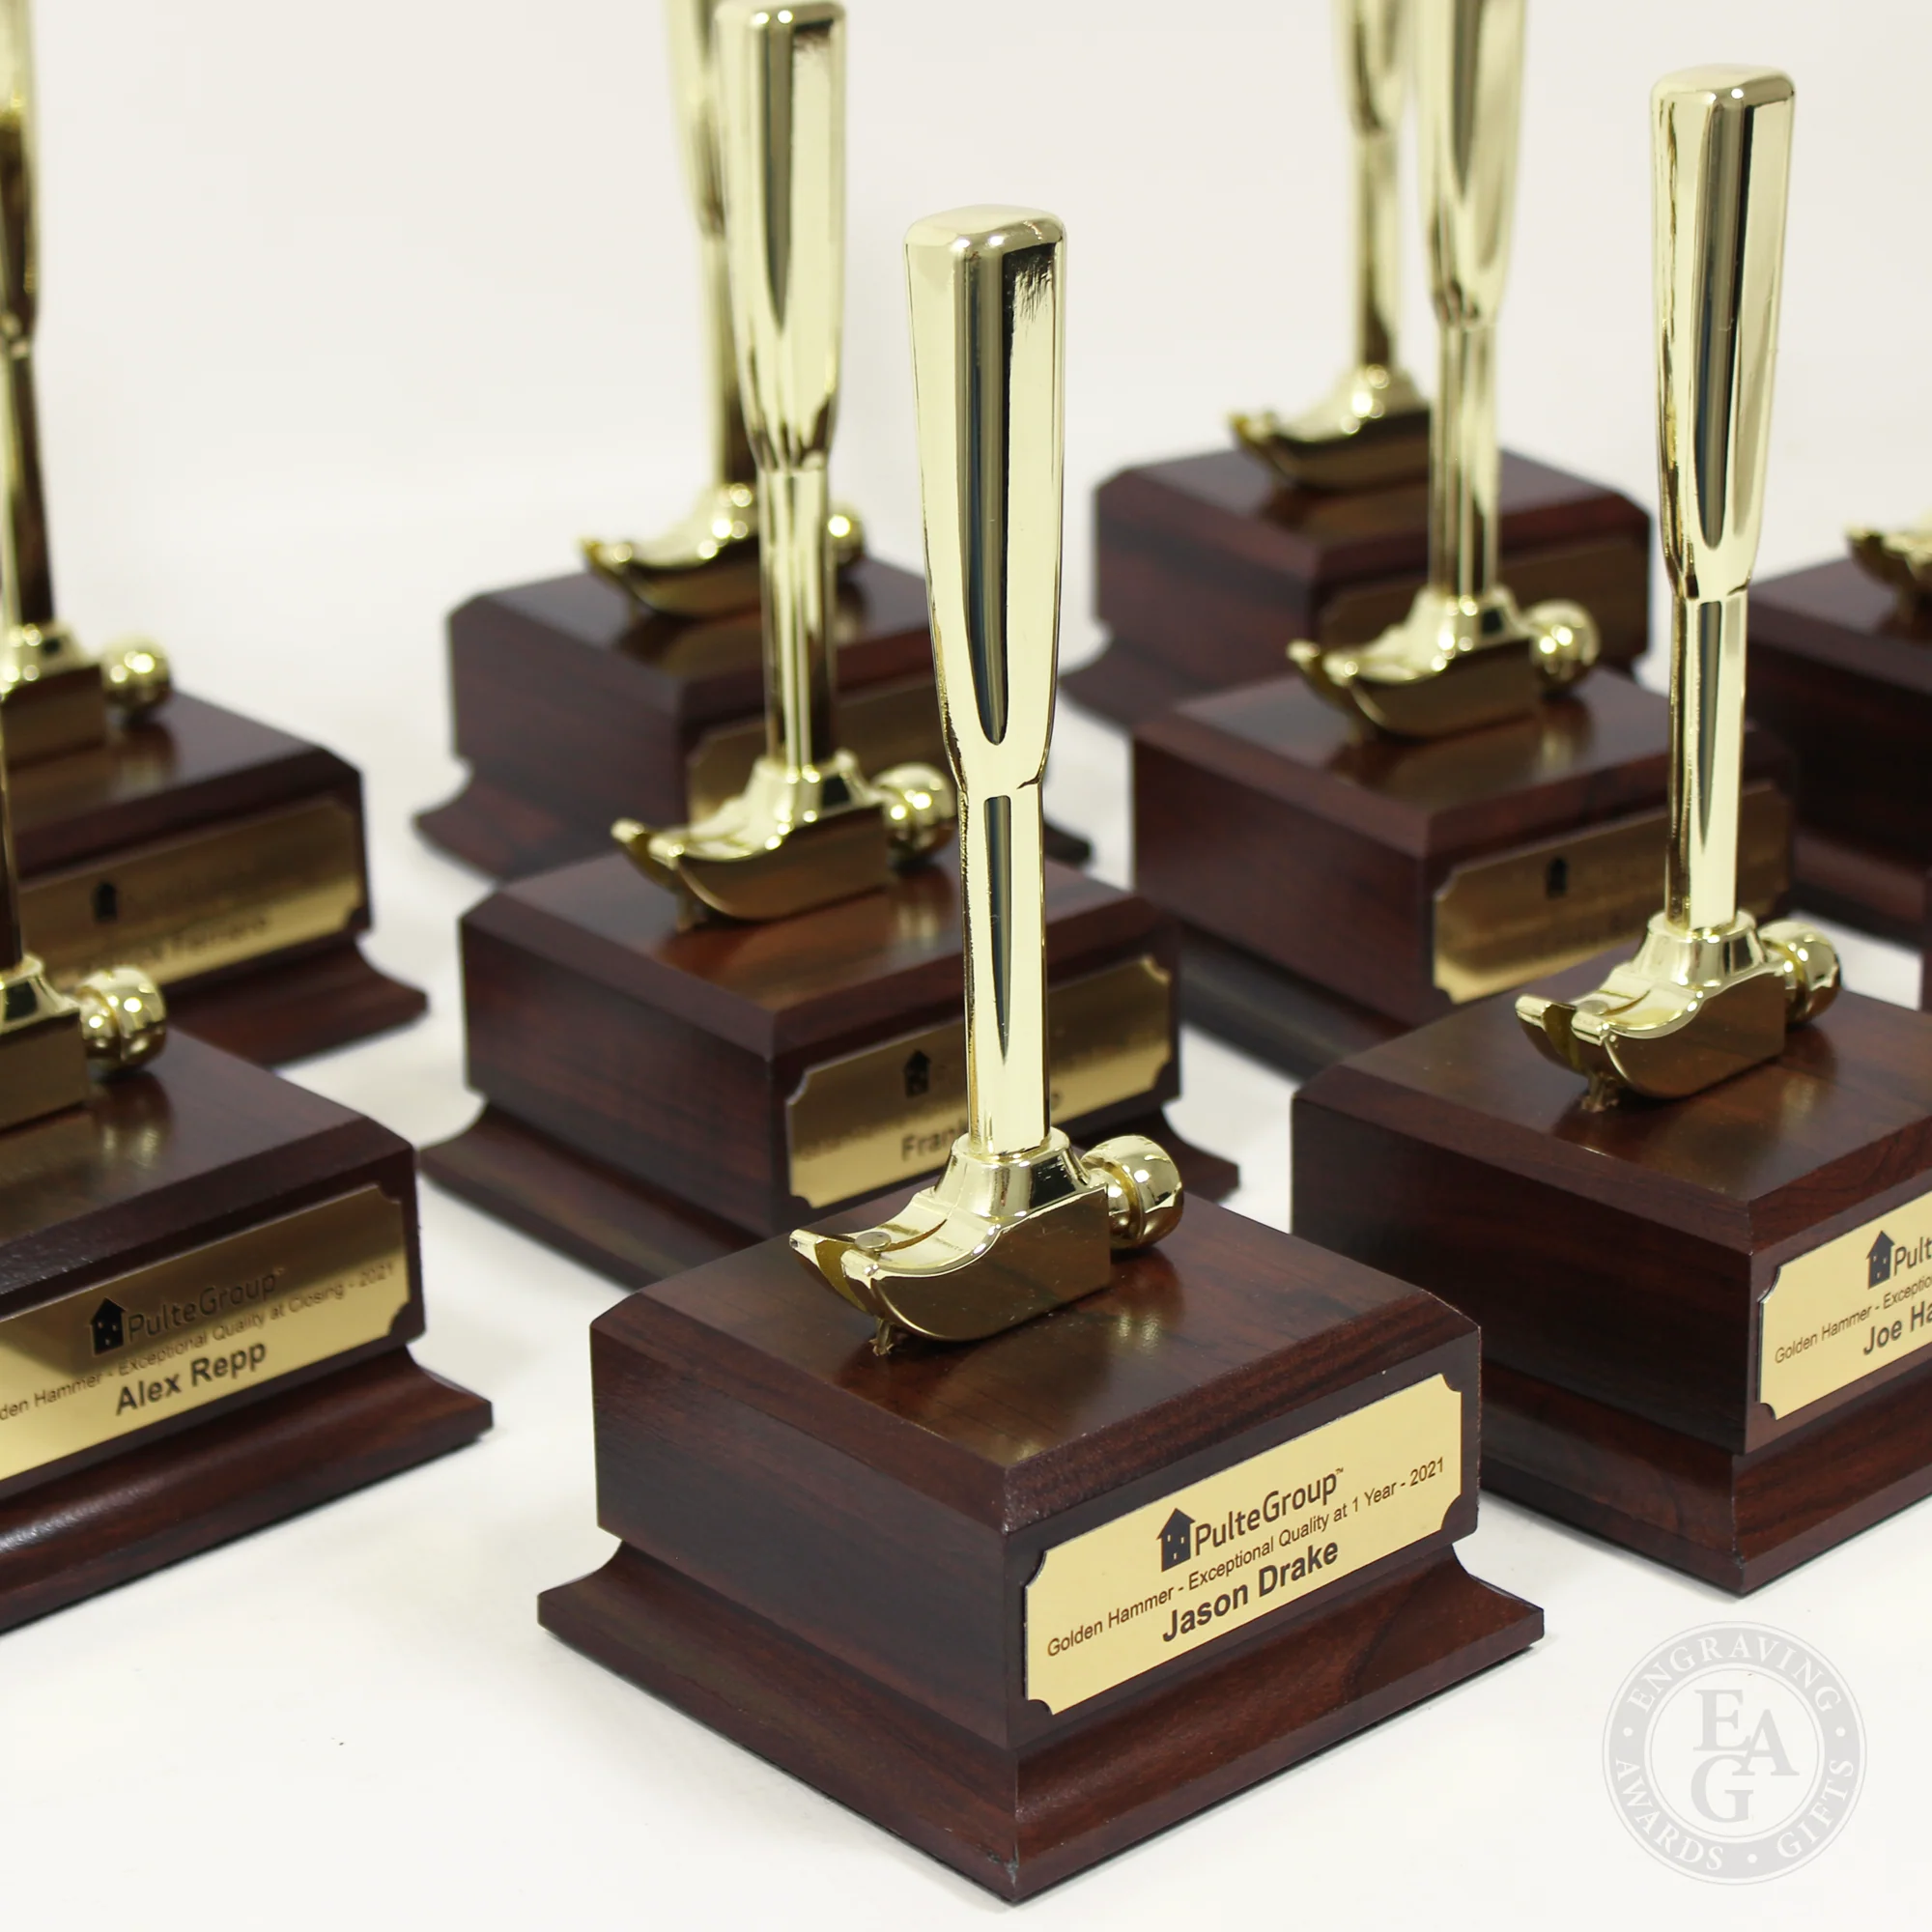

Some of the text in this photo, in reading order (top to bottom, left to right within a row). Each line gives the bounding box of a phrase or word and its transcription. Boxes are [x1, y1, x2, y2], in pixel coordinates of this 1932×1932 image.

[34, 1373, 102, 1407] Hammer
[119, 1330, 208, 1378] Exceptional
[212, 1311, 265, 1342] Quality
[270, 1302, 286, 1321] at
[289, 1282, 345, 1313] Closing
[358, 1262, 394, 1288] 2021
[1775, 1332, 1818, 1364] Golden
[1821, 1304, 1873, 1339] Hammer
[1862, 1319, 1903, 1355] Joe
[116, 1341, 268, 1416] Alex Repp
[1047, 1620, 1103, 1657] Golden
[1108, 1586, 1174, 1630] Hammer
[1188, 1535, 1274, 1591] Exceptional
[1278, 1513, 1330, 1548] Quality
[1333, 1502, 1348, 1523] at
[1351, 1495, 1358, 1513] 1
[1363, 1488, 1397, 1507] Year
[1409, 1456, 1443, 1487] 2021
[1162, 1541, 1339, 1643] Jason Drake
